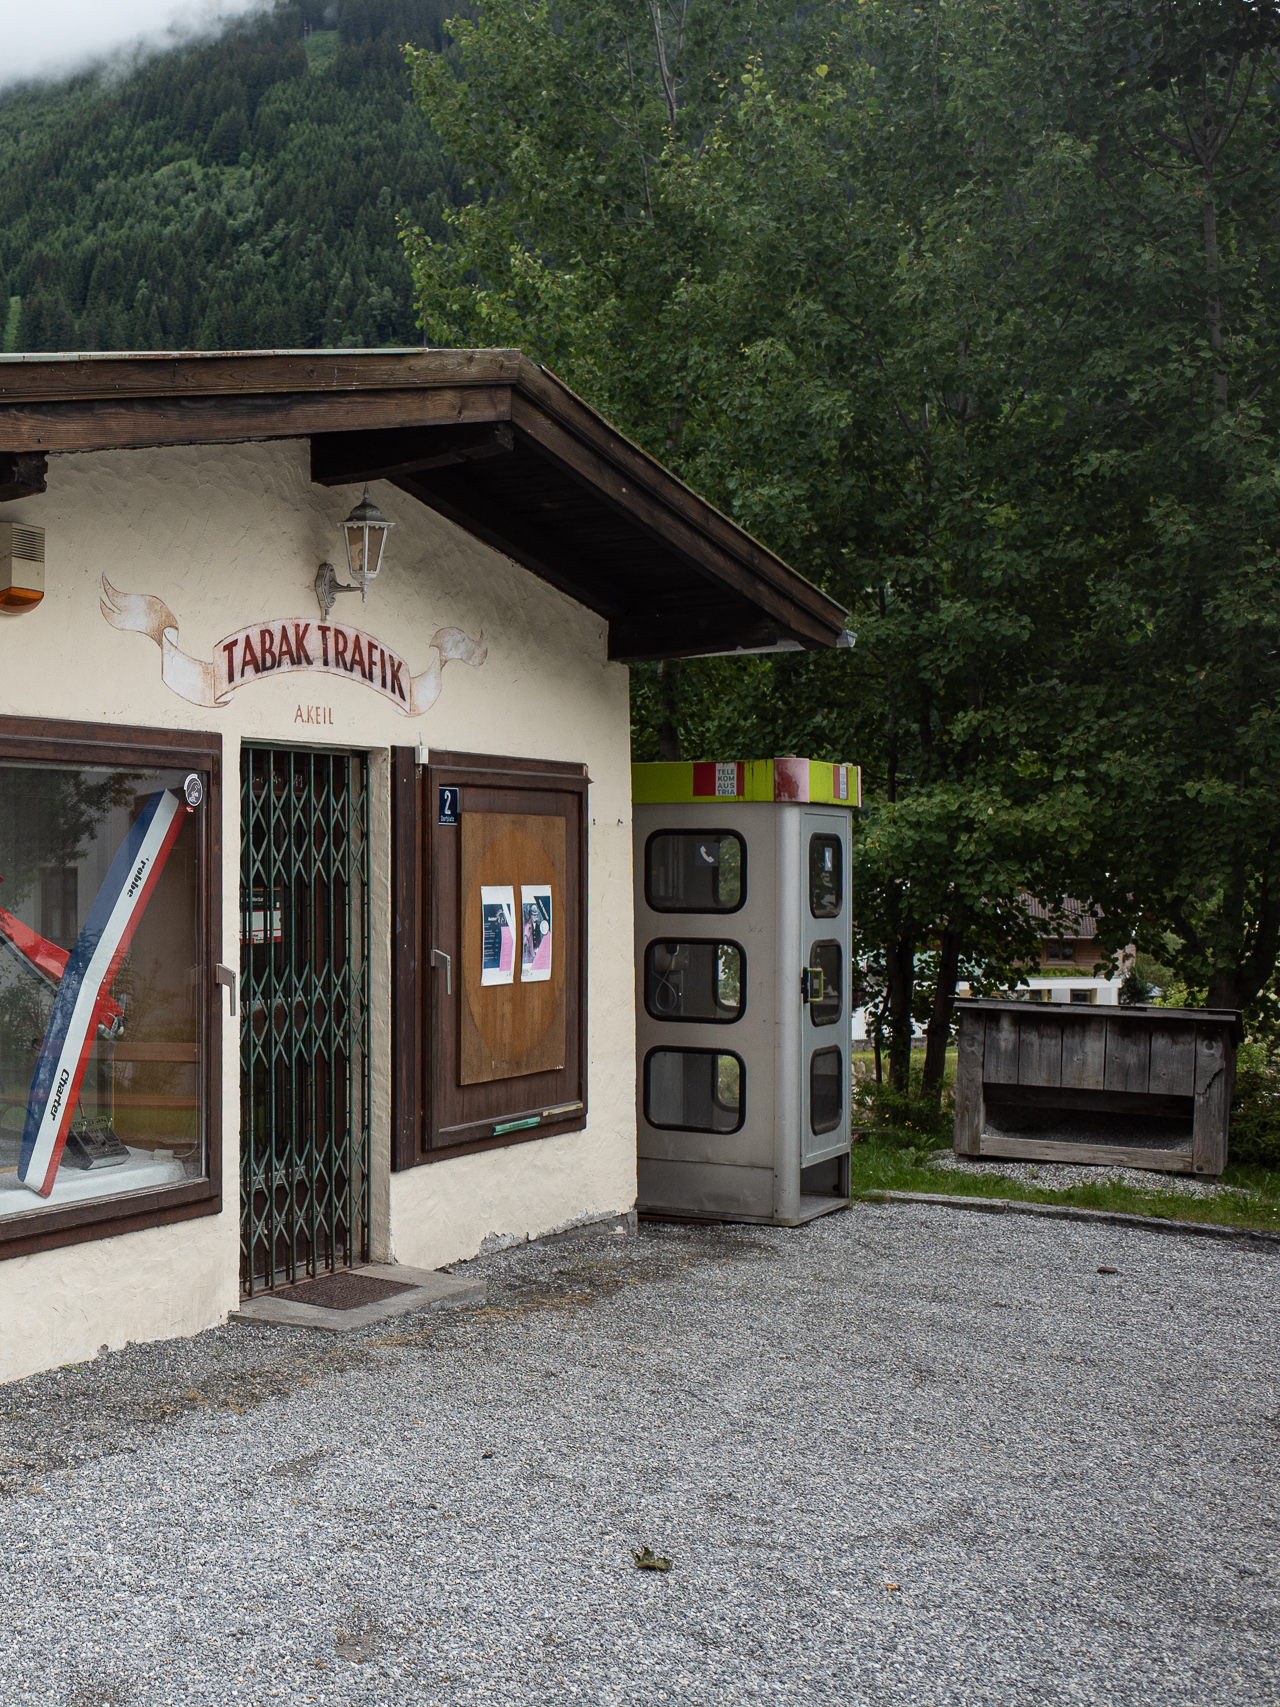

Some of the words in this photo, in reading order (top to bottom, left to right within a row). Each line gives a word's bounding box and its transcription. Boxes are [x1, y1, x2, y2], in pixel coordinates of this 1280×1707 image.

[223, 623, 314, 685] TABAK
[318, 625, 407, 703] TRAFIK
[443, 790, 452, 815] 2
[127, 858, 148, 898] robbe
[50, 1068, 70, 1121] Charter
